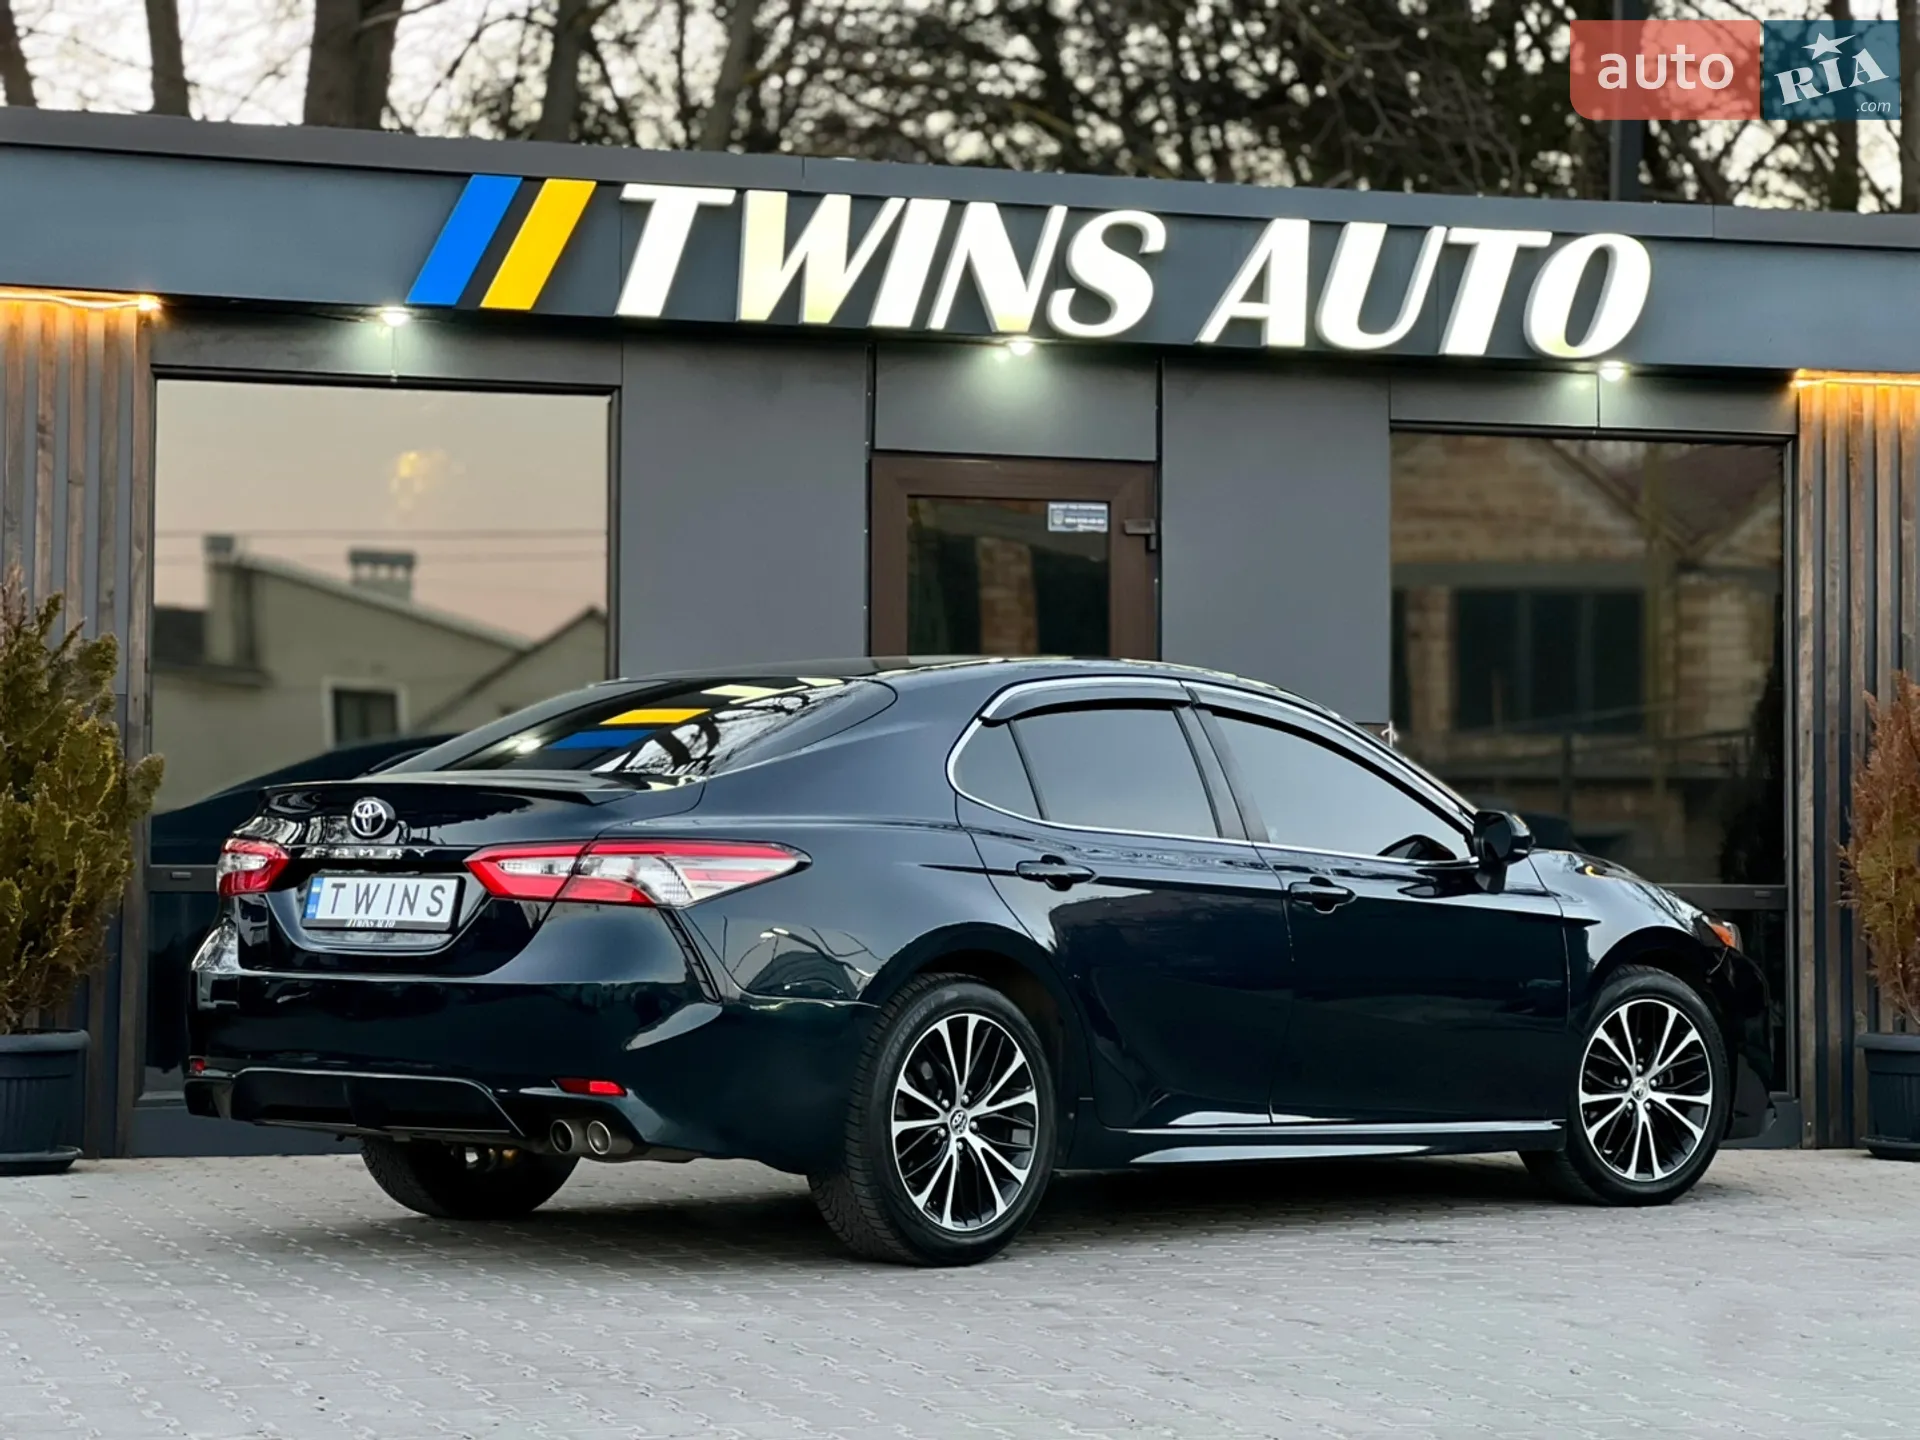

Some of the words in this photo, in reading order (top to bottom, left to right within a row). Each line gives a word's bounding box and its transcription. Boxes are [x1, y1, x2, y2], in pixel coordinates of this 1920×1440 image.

[616, 182, 1168, 338] TWINS
[1193, 218, 1653, 360] AUTO
[312, 847, 433, 858] CAMRY
[331, 883, 446, 917] TWINS
